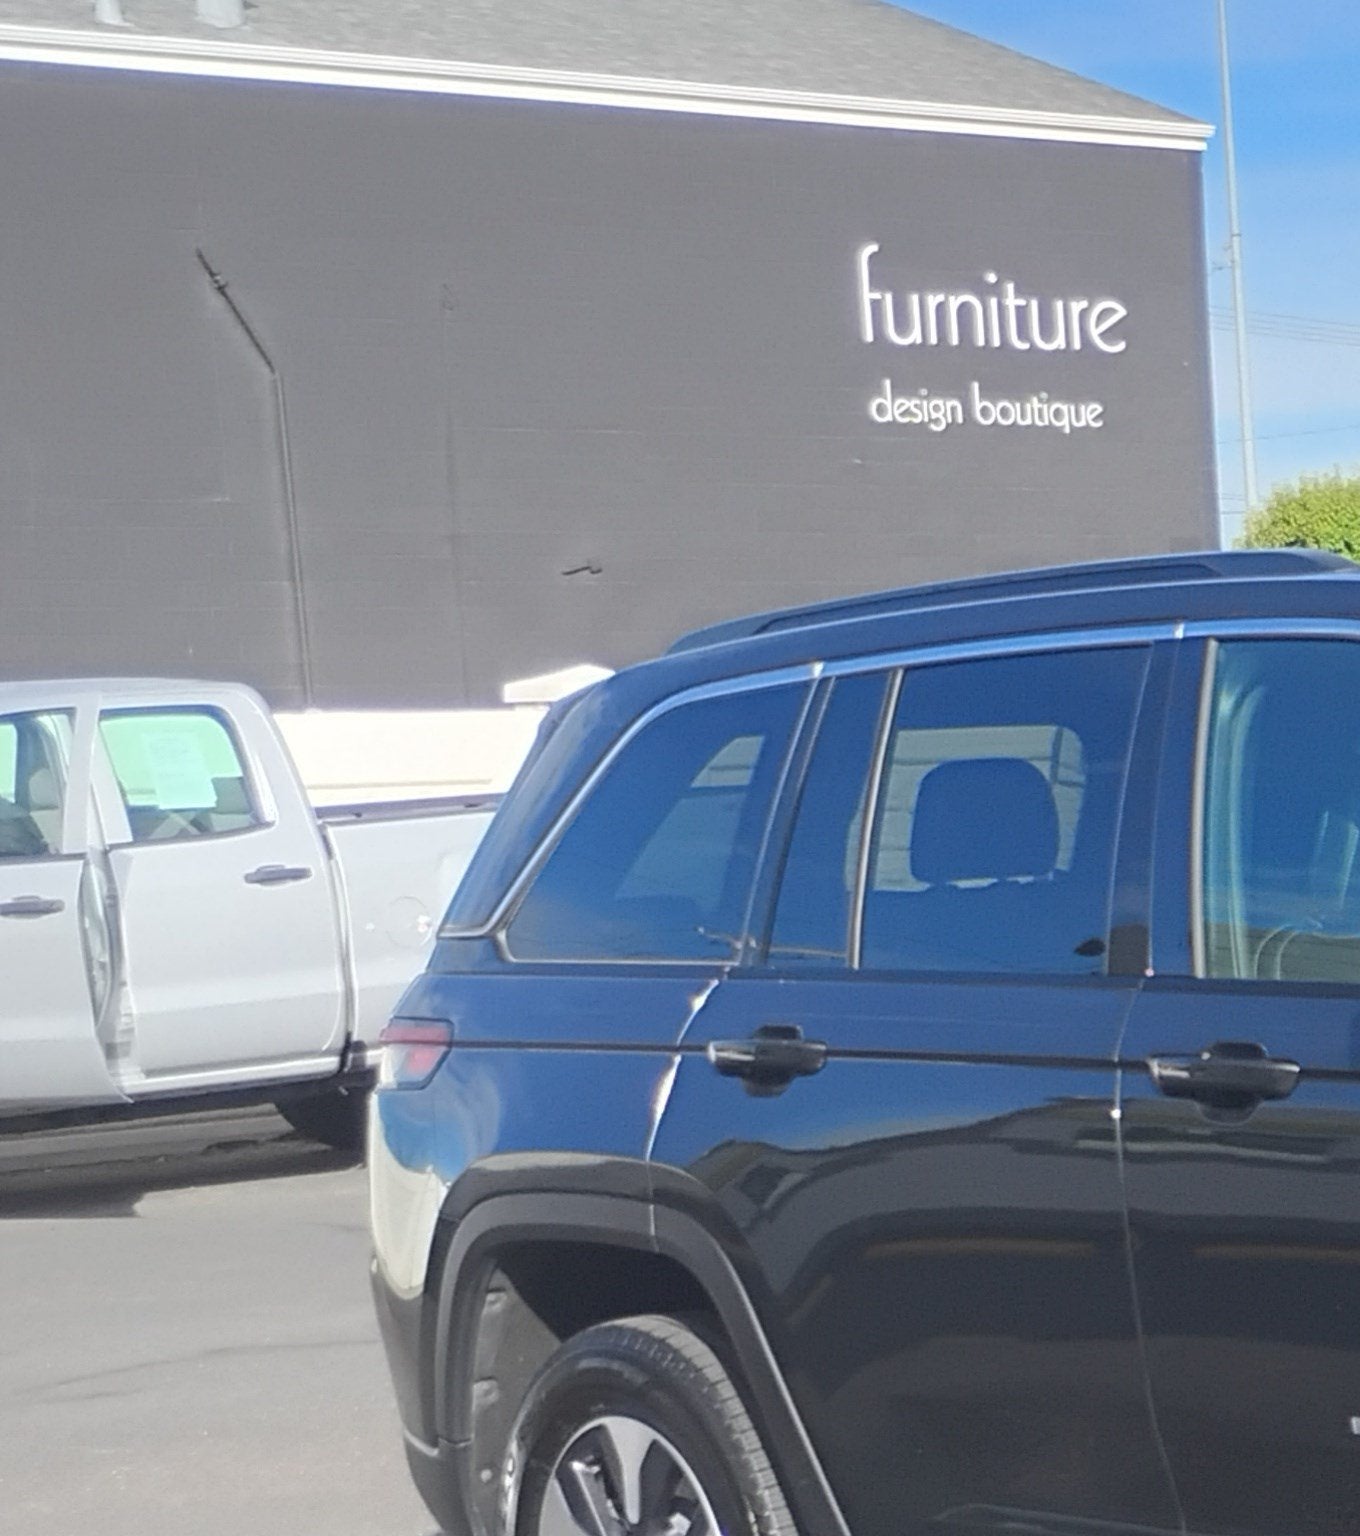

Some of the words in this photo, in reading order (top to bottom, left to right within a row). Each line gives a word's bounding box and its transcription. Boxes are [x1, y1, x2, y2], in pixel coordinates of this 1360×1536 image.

[858, 242, 1127, 353] furniture
[870, 379, 963, 431] design
[972, 381, 1104, 433] boutique
